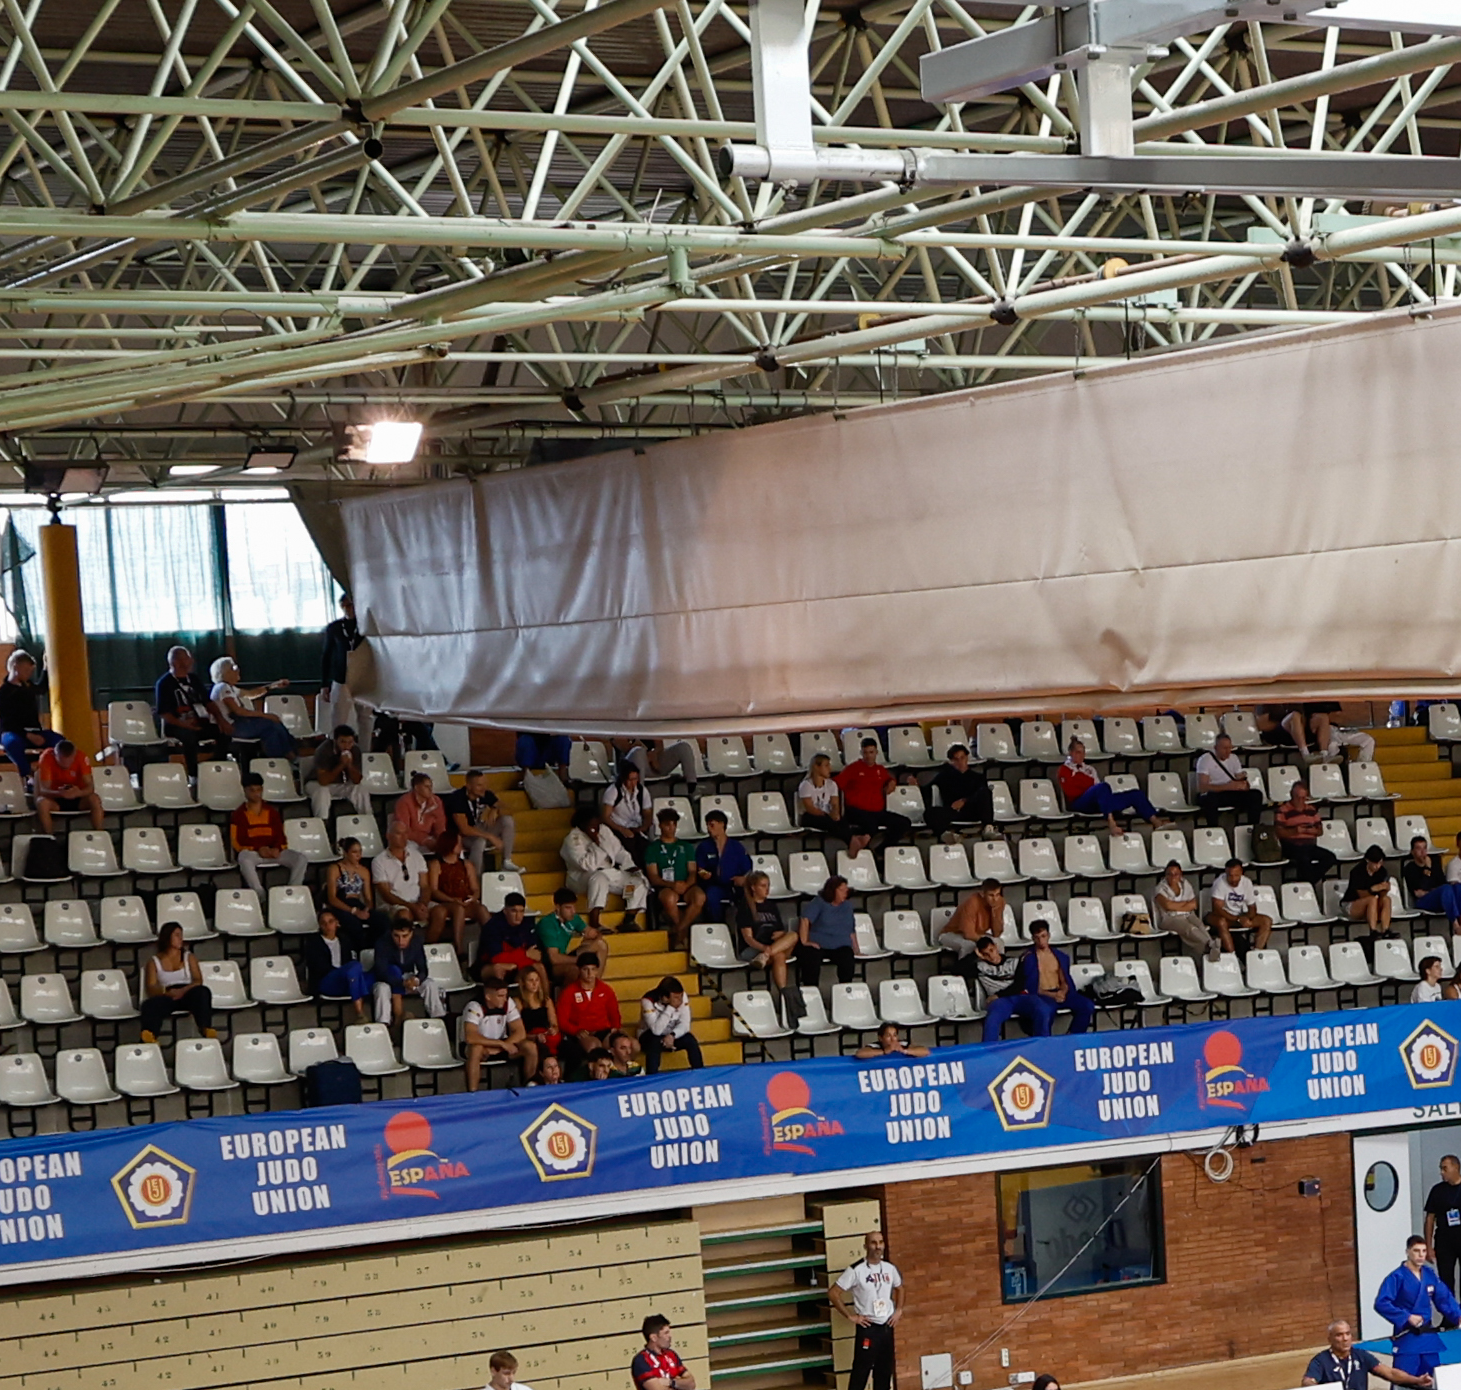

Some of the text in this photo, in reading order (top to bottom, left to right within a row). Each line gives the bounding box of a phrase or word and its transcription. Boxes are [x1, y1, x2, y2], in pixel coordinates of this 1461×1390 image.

[1073, 1041, 1173, 1072] EUROPEAN
[1102, 1069, 1151, 1096] JUDO
[618, 1084, 733, 1118] EUROPEAN
[1097, 1093, 1160, 1122] UNION
[219, 1124, 347, 1161] EUROPEAN
[653, 1113, 710, 1142] JUDO
[649, 1139, 719, 1170] UNION
[256, 1157, 318, 1187] JUDO
[251, 1185, 330, 1216] UNION
